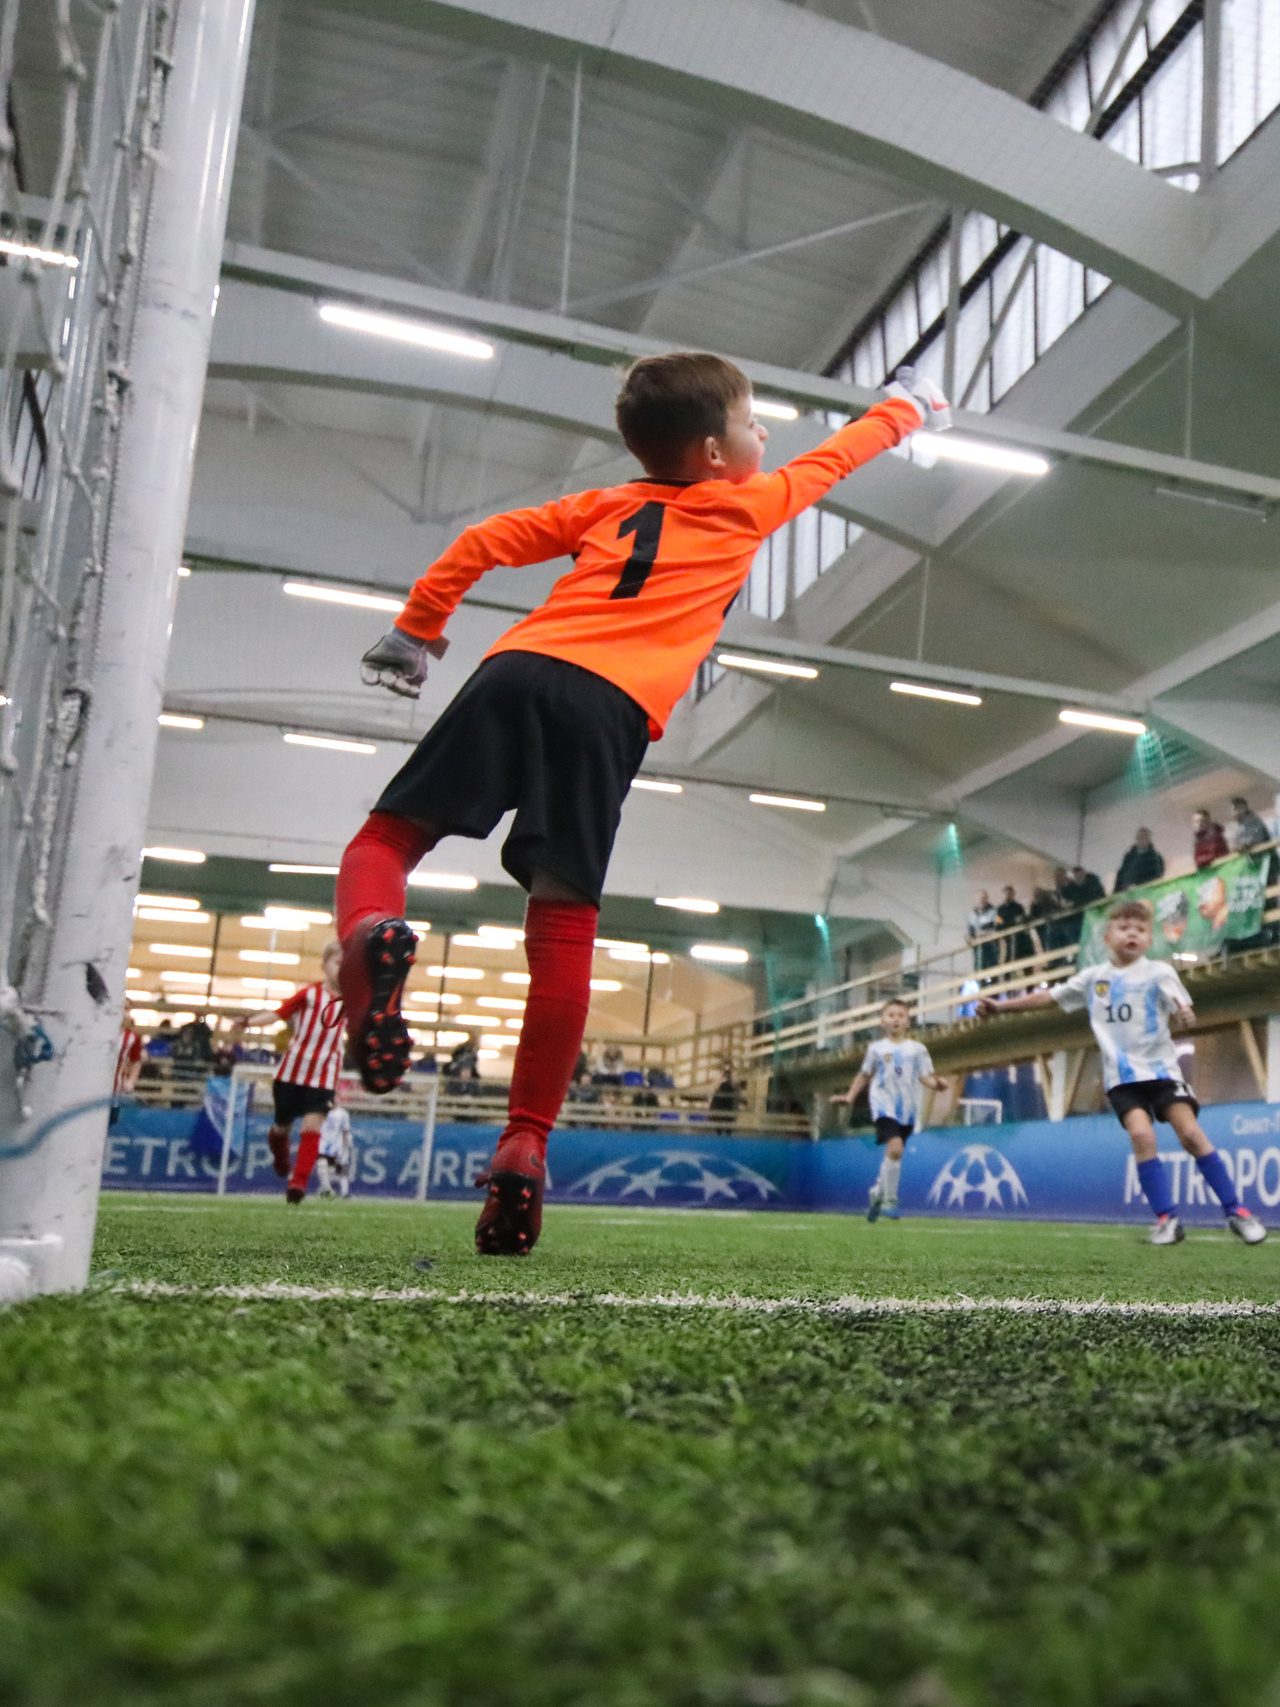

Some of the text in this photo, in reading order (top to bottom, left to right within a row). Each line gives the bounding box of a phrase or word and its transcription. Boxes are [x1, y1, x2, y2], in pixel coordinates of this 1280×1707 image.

[609, 500, 666, 599] 1
[1105, 1003, 1132, 1023] 10
[397, 1149, 553, 1190] ARE
